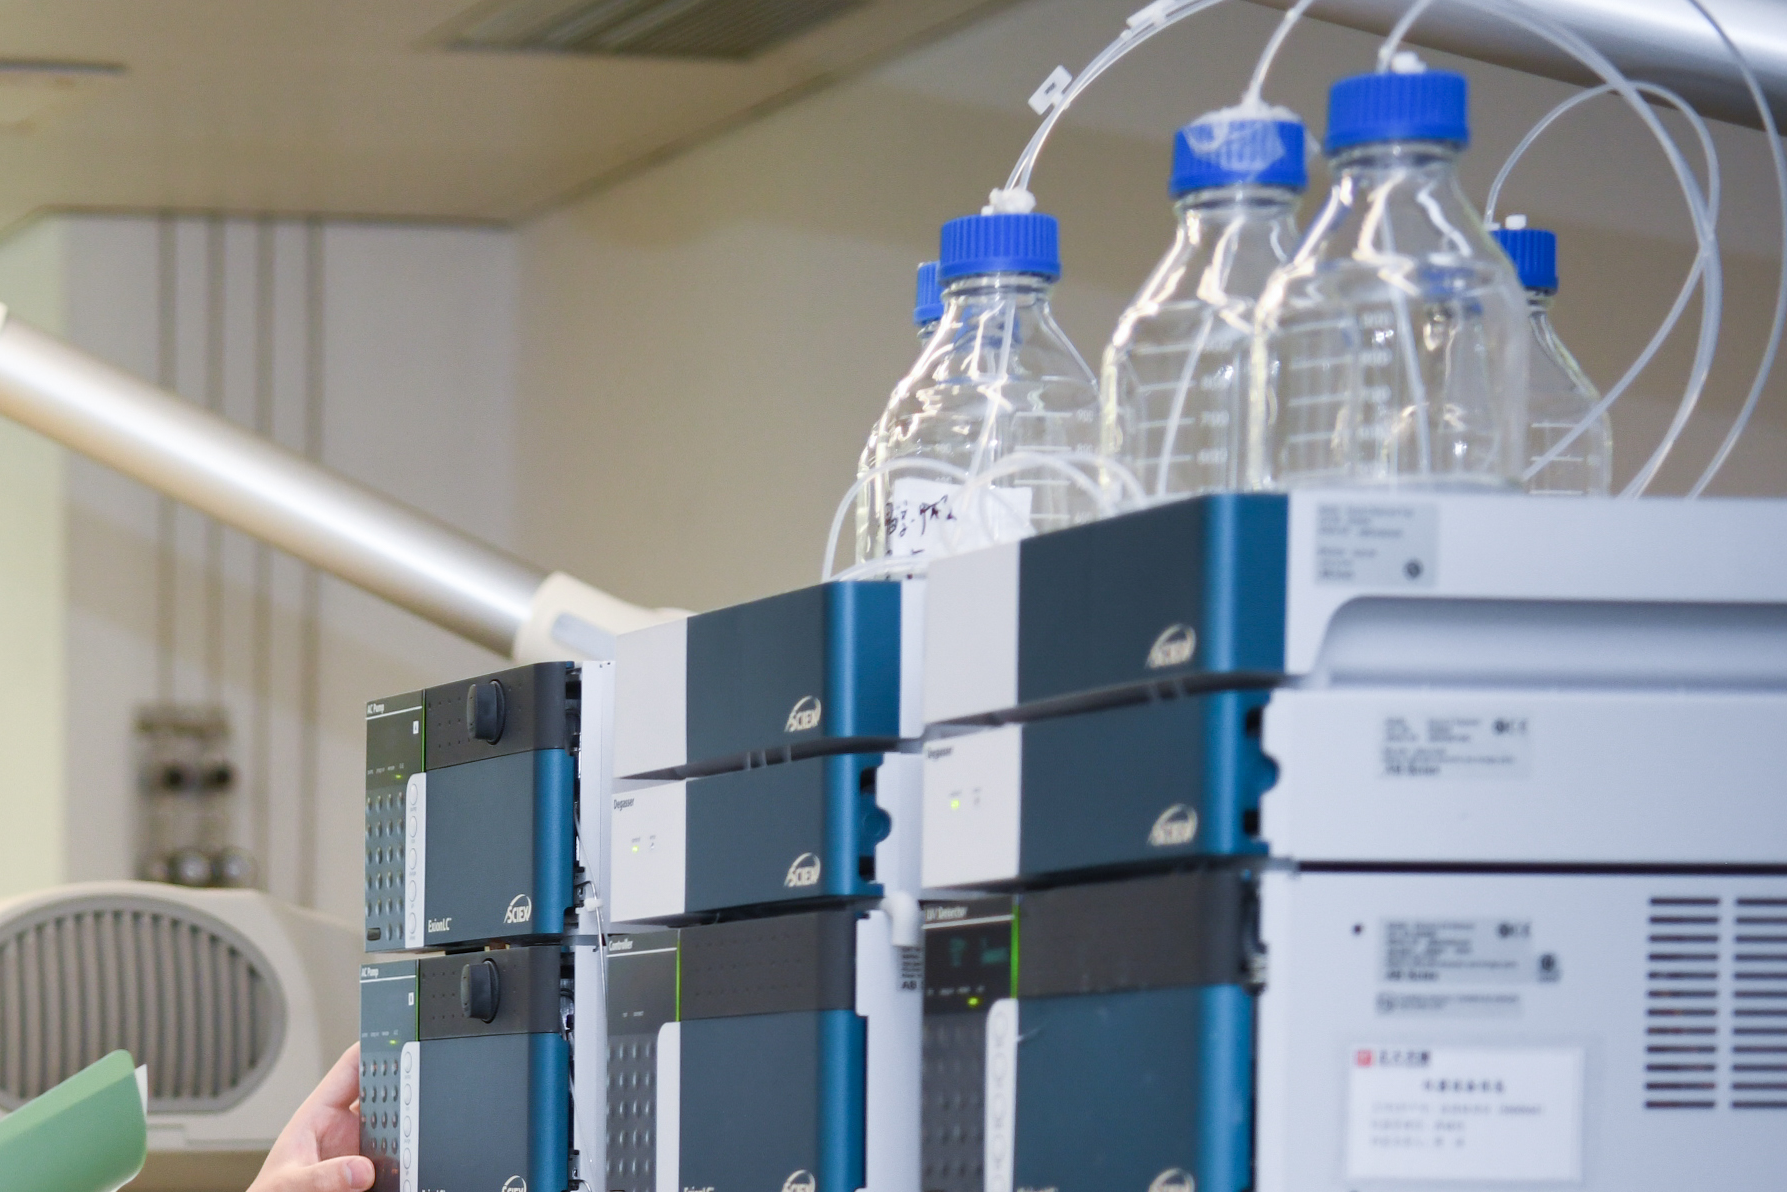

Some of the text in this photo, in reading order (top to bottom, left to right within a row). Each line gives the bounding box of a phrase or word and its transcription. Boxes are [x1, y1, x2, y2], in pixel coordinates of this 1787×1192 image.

[614, 798, 635, 811] Degasser
[506, 901, 531, 924] SCIEX
[609, 938, 633, 951] Controller
